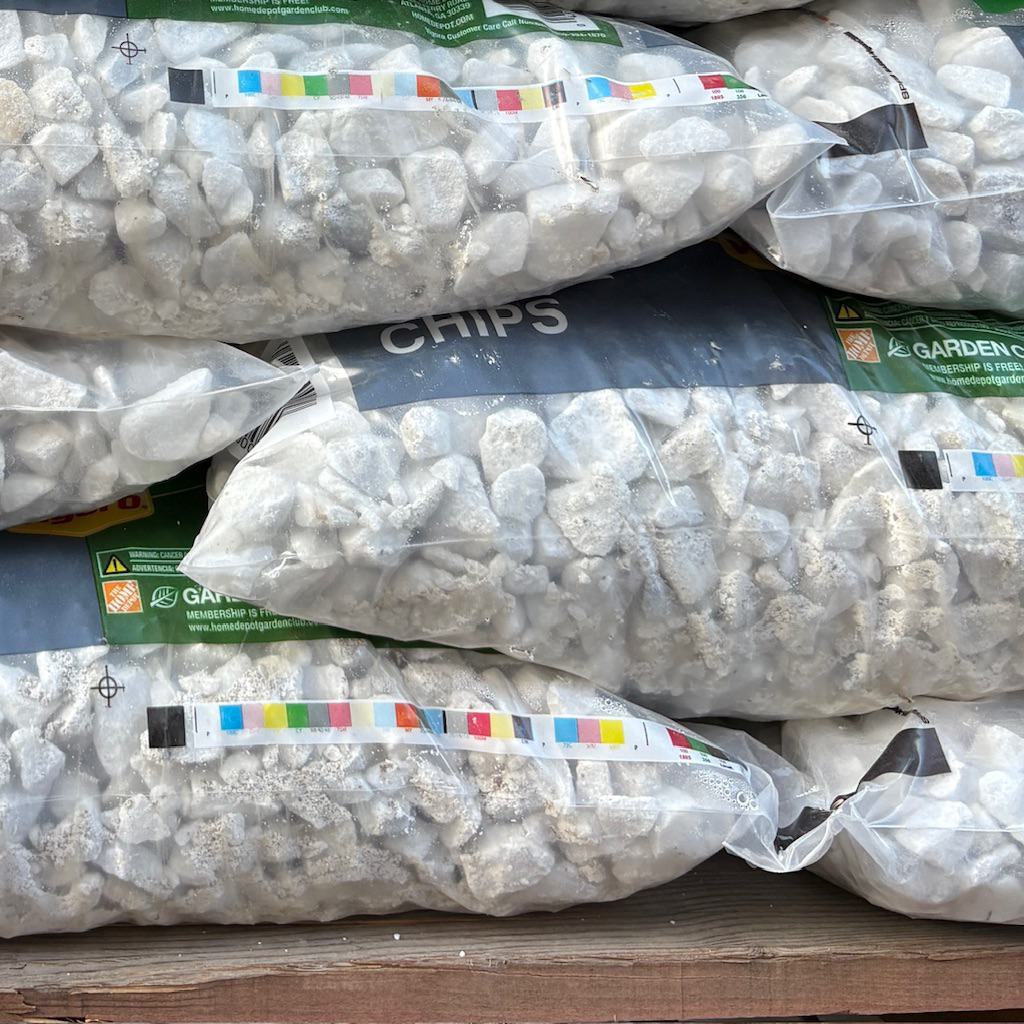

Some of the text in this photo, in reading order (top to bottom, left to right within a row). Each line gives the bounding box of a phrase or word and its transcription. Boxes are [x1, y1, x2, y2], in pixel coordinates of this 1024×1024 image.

[210, 3, 349, 15] www.homedepotgardenclub.com
[446, 3, 471, 16] 30339
[411, 10, 474, 30] HOMEDEPOT.COM
[447, 25, 481, 41] Customer
[483, 21, 501, 31] Care
[502, 18, 517, 27] Call
[380, 297, 568, 355] CHIPS
[912, 339, 1012, 359] GARDEN
[923, 362, 1024, 375] MEMBERSHIP IS FREE!
[132, 564, 175, 573] ADVERTENCIA:
[107, 580, 138, 613] HOME
[186, 608, 247, 620] MEMBERSHIP
[248, 608, 258, 618] IS
